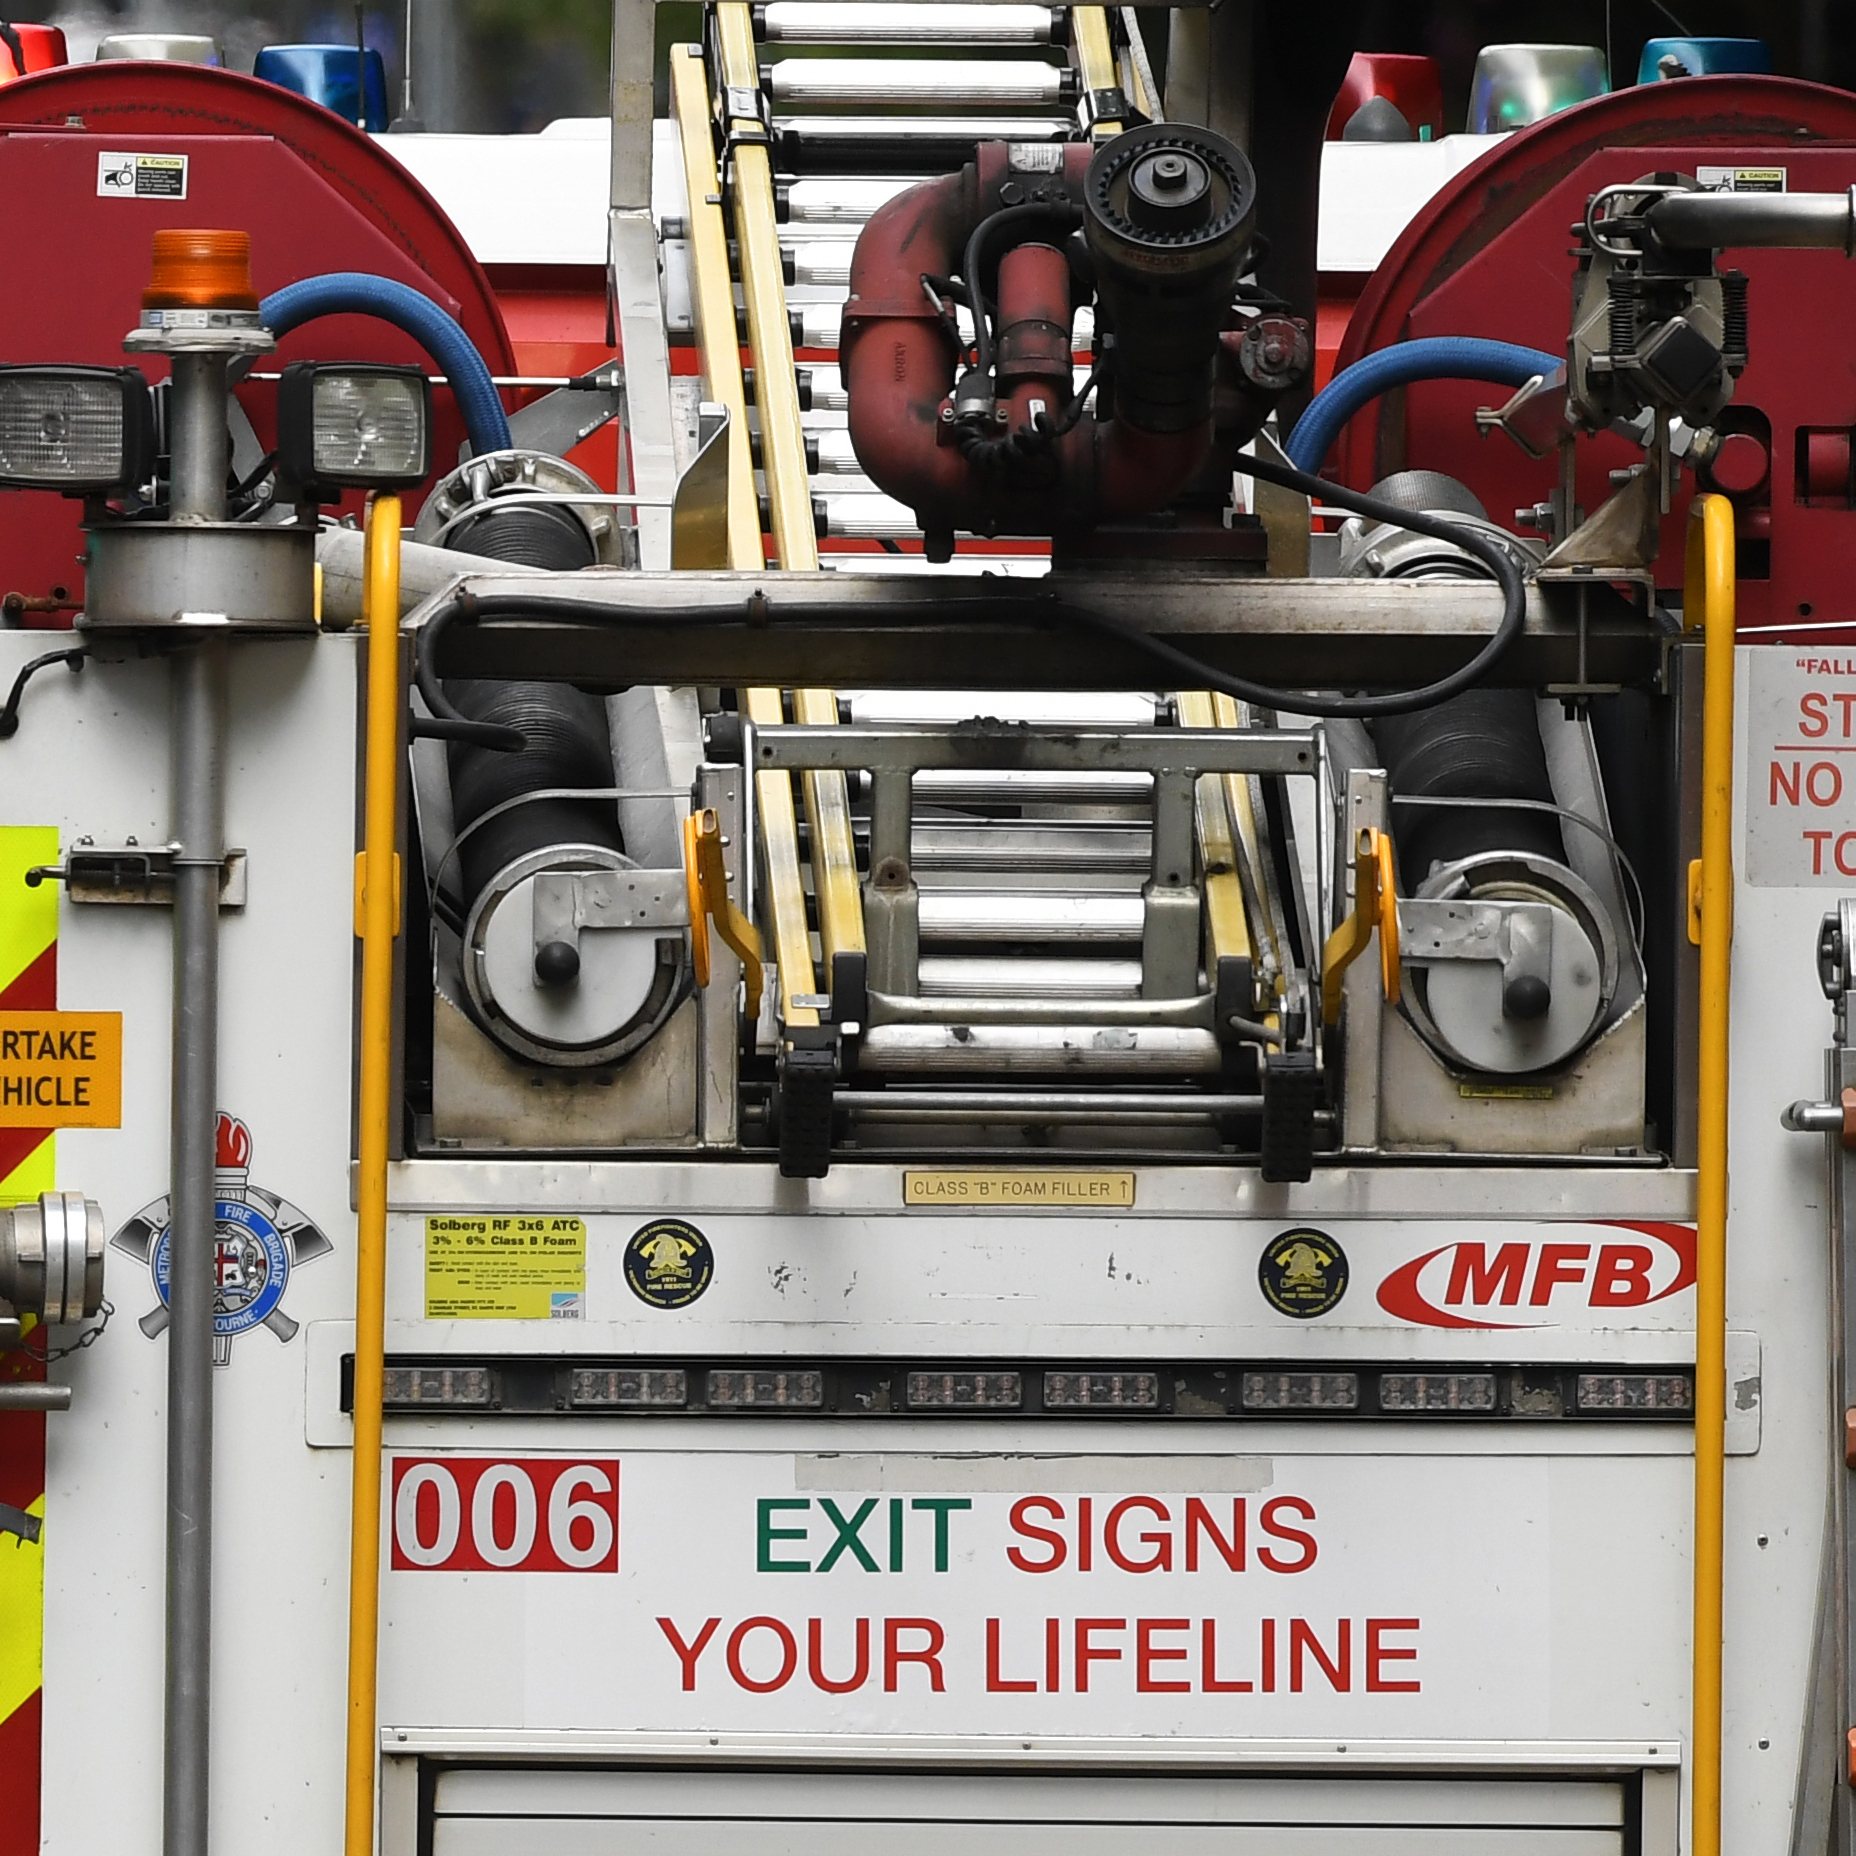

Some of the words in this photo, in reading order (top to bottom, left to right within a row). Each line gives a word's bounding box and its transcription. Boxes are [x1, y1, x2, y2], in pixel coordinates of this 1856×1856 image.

[1770, 761, 1842, 807] NO
[914, 1182, 968, 1195] CLASS
[1002, 1182, 1046, 1196] FOAM
[1052, 1183, 1110, 1196] FILLER
[225, 1205, 252, 1223] FIRE
[264, 1233, 281, 1288] BRIGADE
[430, 1220, 486, 1233] Solberg
[492, 1220, 511, 1231] RF
[517, 1220, 544, 1231] 3x6
[551, 1220, 580, 1231] ATC
[432, 1236, 452, 1246] 3%
[466, 1236, 485, 1246] 6%
[491, 1236, 524, 1246] Class
[530, 1236, 538, 1246] B
[543, 1236, 577, 1246] Foam
[1444, 1242, 1654, 1308] MFB
[395, 1463, 613, 1567] 006
[758, 1500, 970, 1572] EXIT
[1007, 1496, 1318, 1574] SIGNS
[657, 1616, 945, 1694] YOUR
[986, 1618, 1421, 1693] LIFELINE
